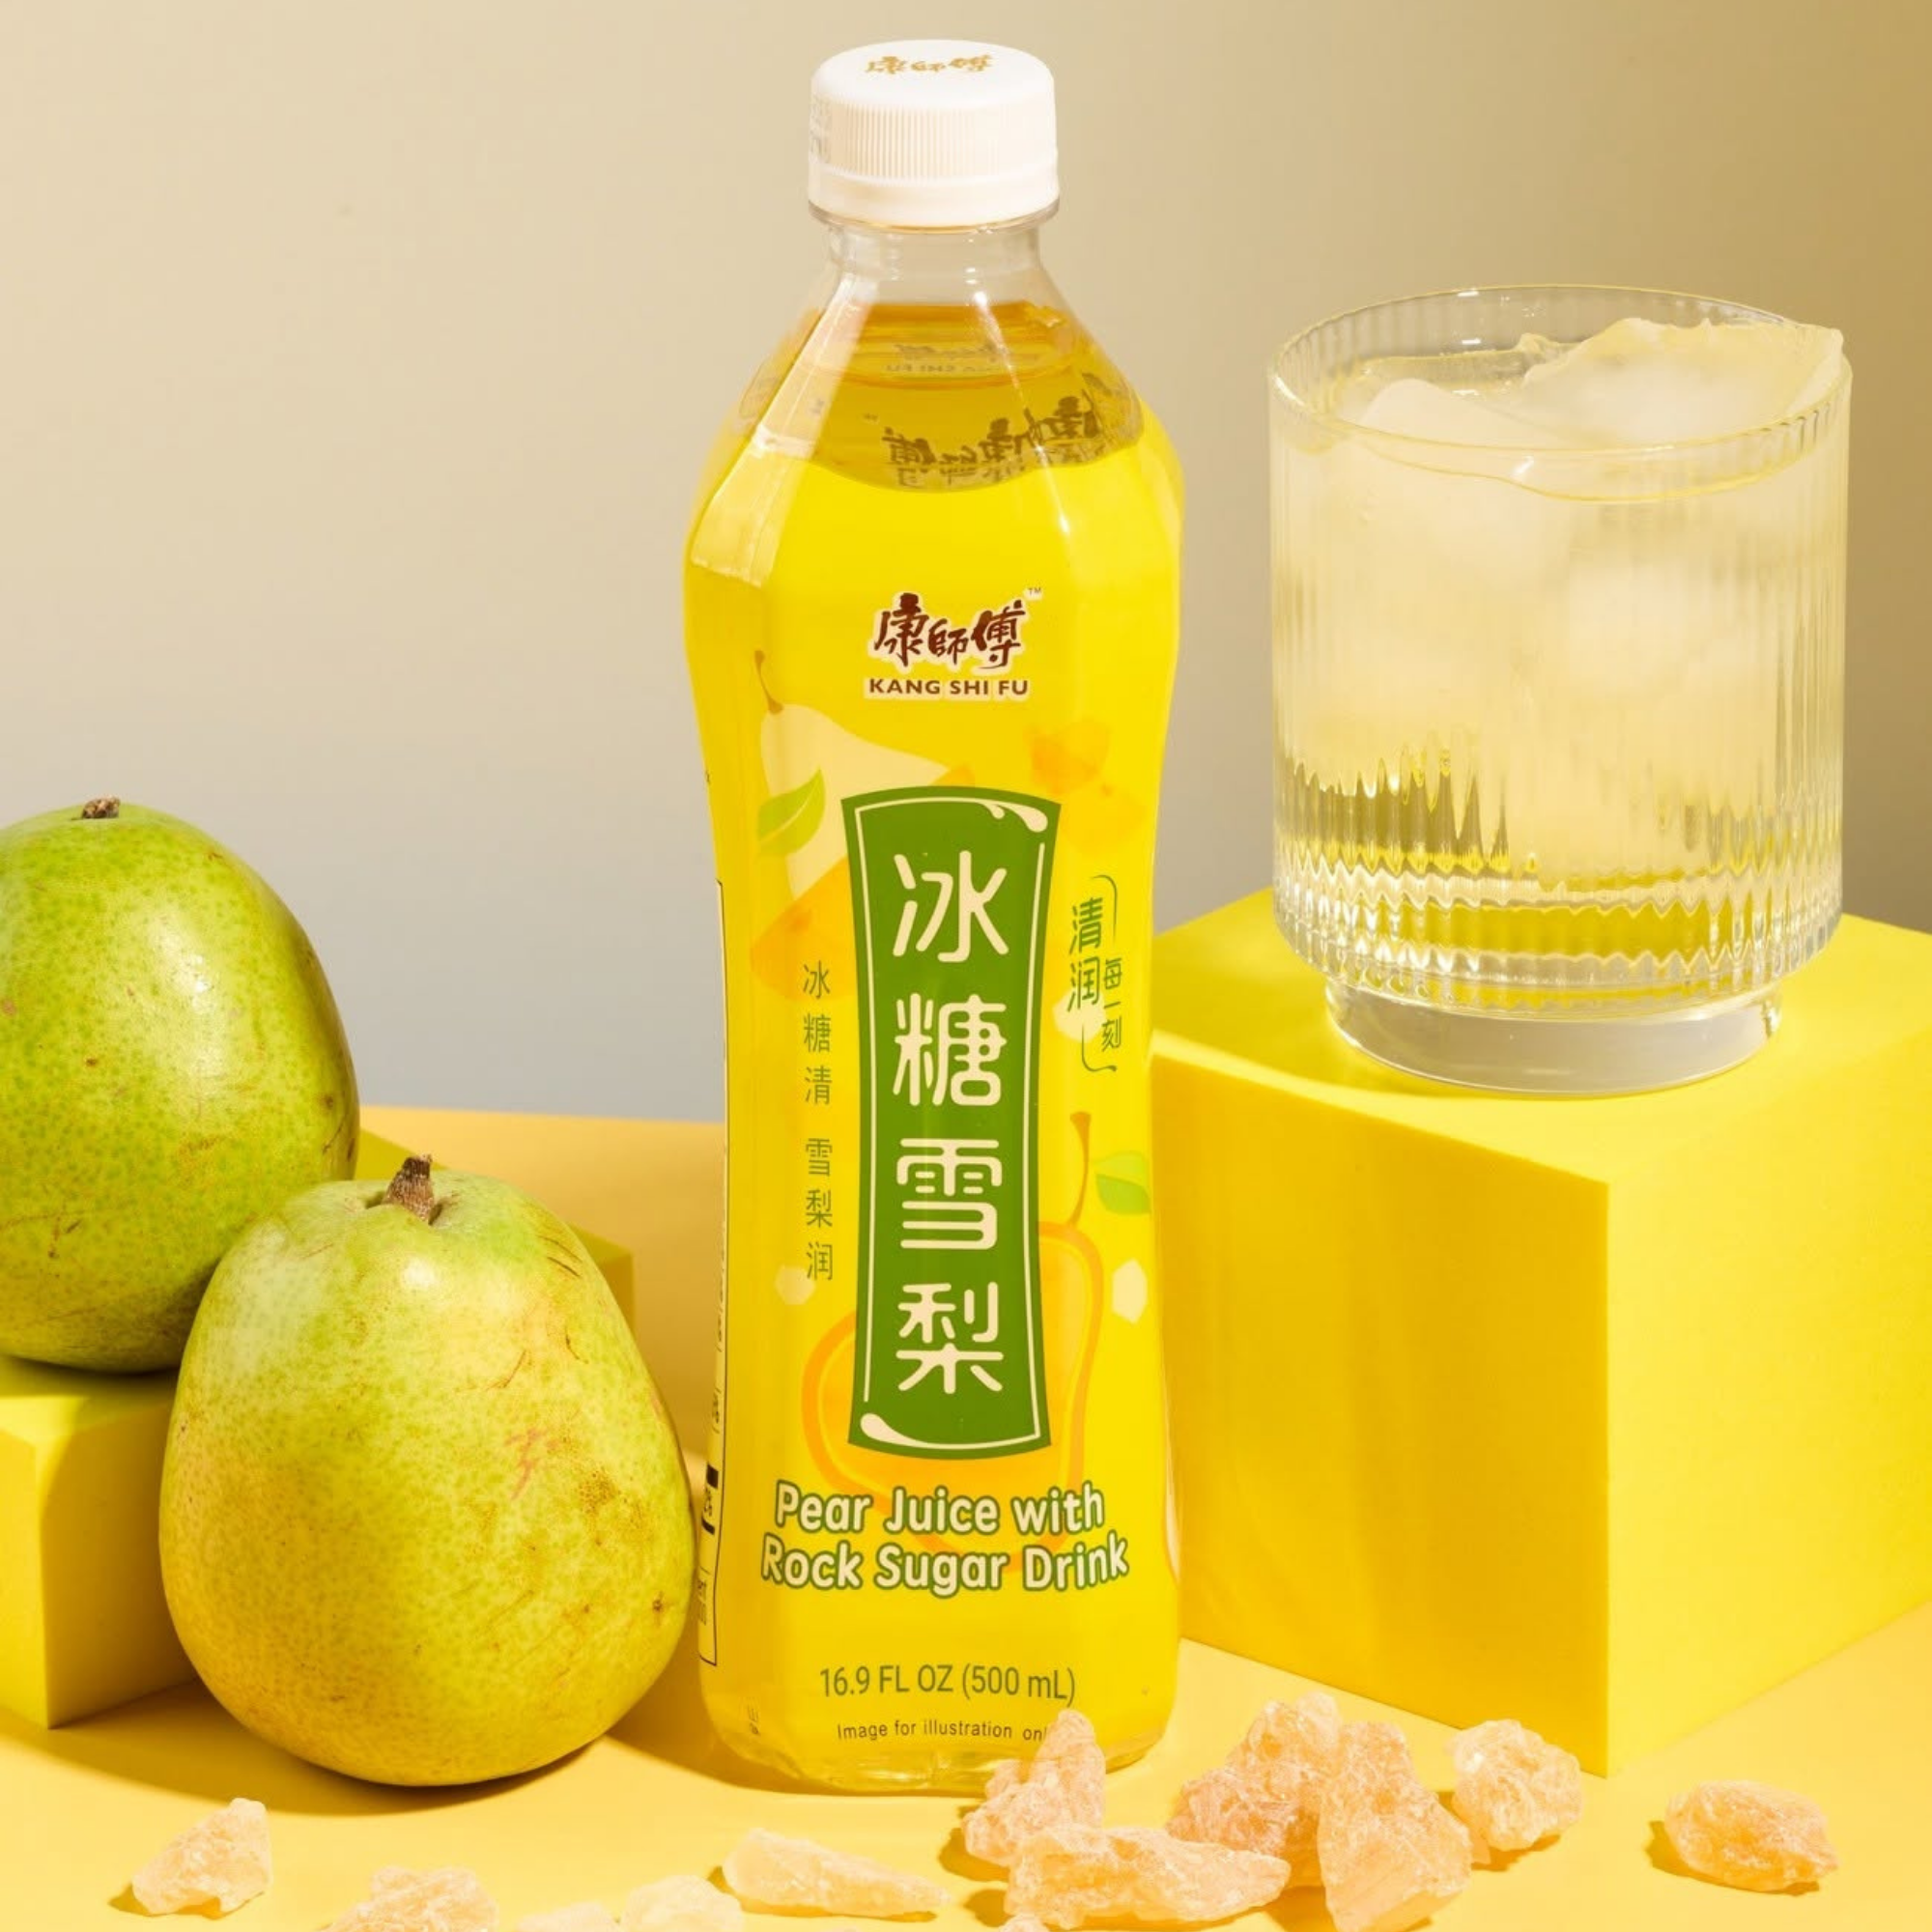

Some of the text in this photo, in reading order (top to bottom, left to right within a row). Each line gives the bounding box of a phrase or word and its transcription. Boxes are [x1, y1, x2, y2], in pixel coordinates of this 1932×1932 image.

[874, 592, 1026, 668] 康師傅
[869, 678, 1029, 696] KANG SHI FU
[1066, 896, 1104, 1013] 清润
[1100, 957, 1122, 1052] 每一刻
[803, 959, 834, 1282] 冰糖清 雪梨润
[893, 850, 1009, 1395] 冰糖雪梨
[775, 1480, 873, 1533] Pear
[884, 1485, 1001, 1535] Juice
[1011, 1480, 1105, 1535] with
[760, 1529, 1129, 1599] Rock Sugar Drink
[820, 1663, 1076, 1708] 16.9 FL OZ (500 mL)
[838, 1723, 888, 1741] Image
[895, 1719, 916, 1736] for
[923, 1719, 1012, 1739] illustration
